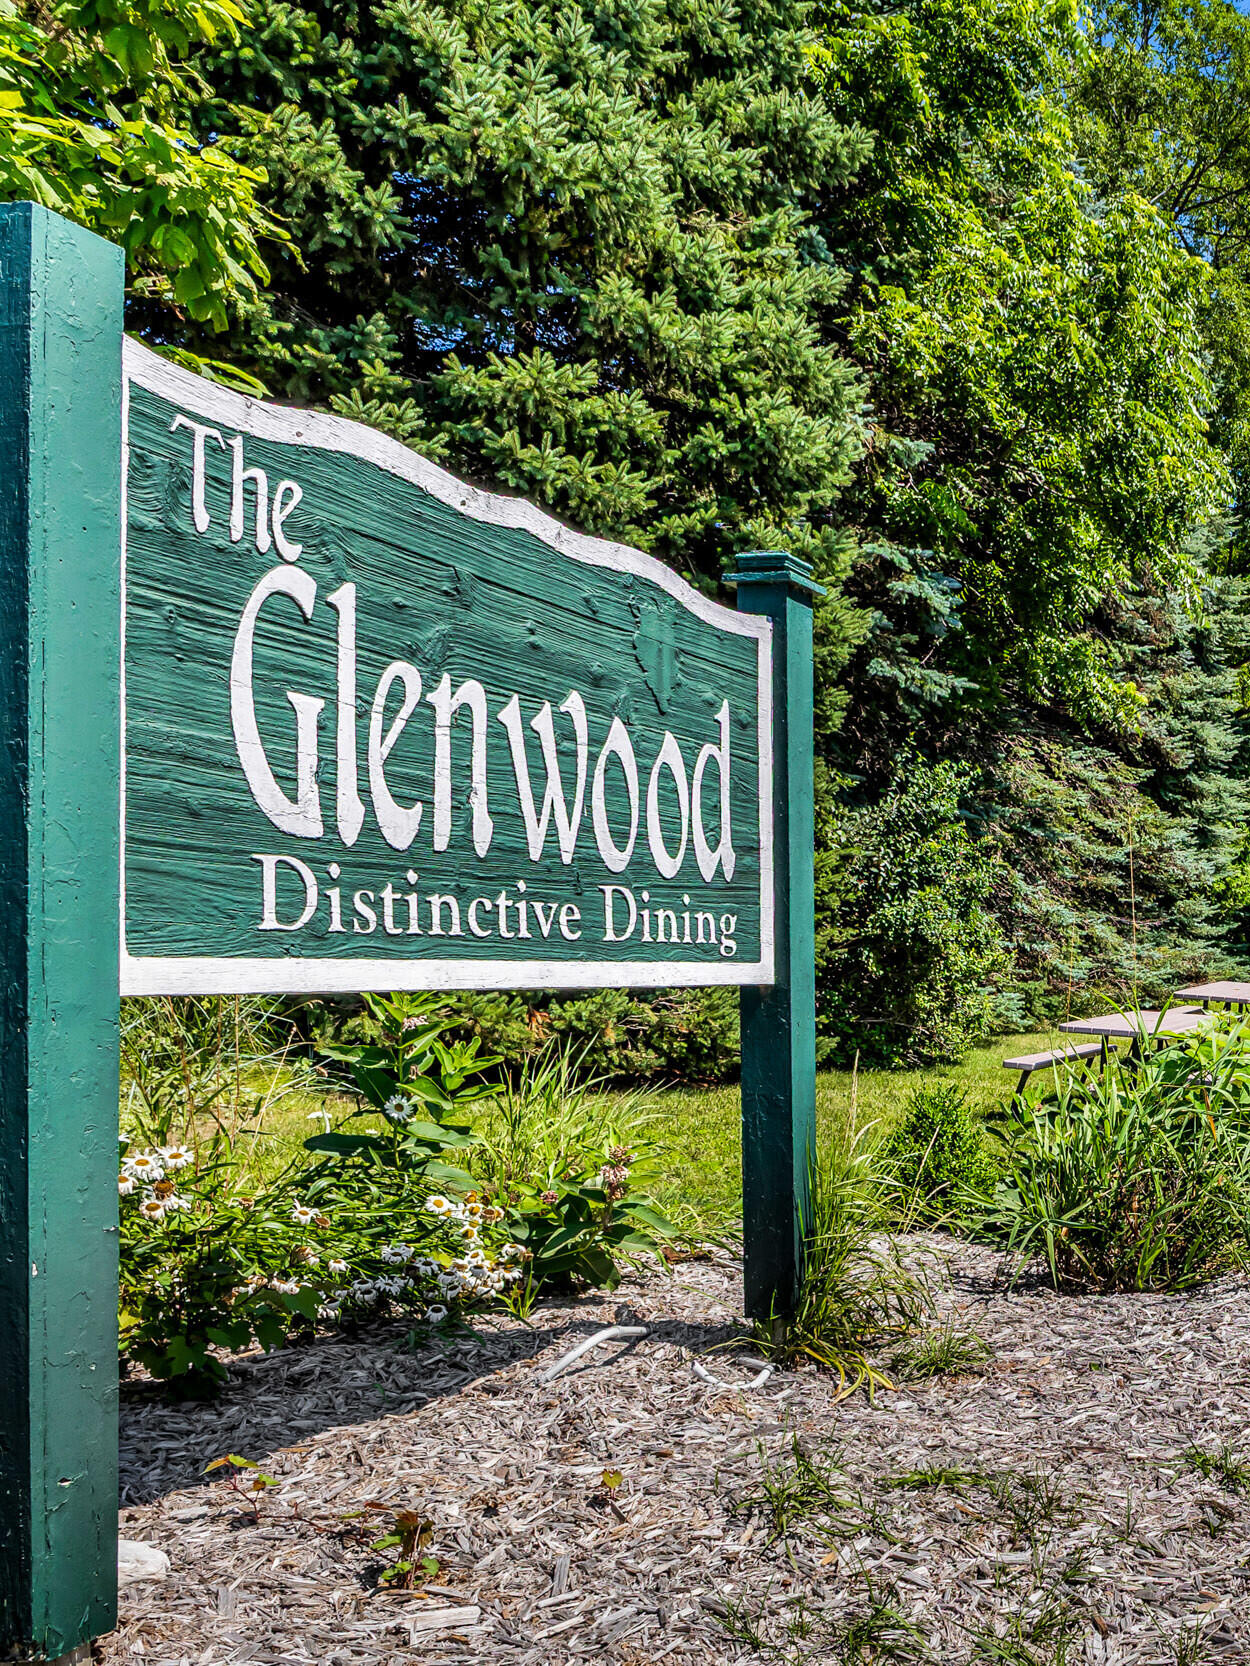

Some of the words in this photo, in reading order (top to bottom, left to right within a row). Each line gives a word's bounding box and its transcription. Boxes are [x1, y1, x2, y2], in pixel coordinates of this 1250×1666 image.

[169, 415, 303, 562] The
[230, 564, 736, 882] Glenwood
[251, 853, 582, 941] Distinctive
[598, 884, 738, 957] Dining
